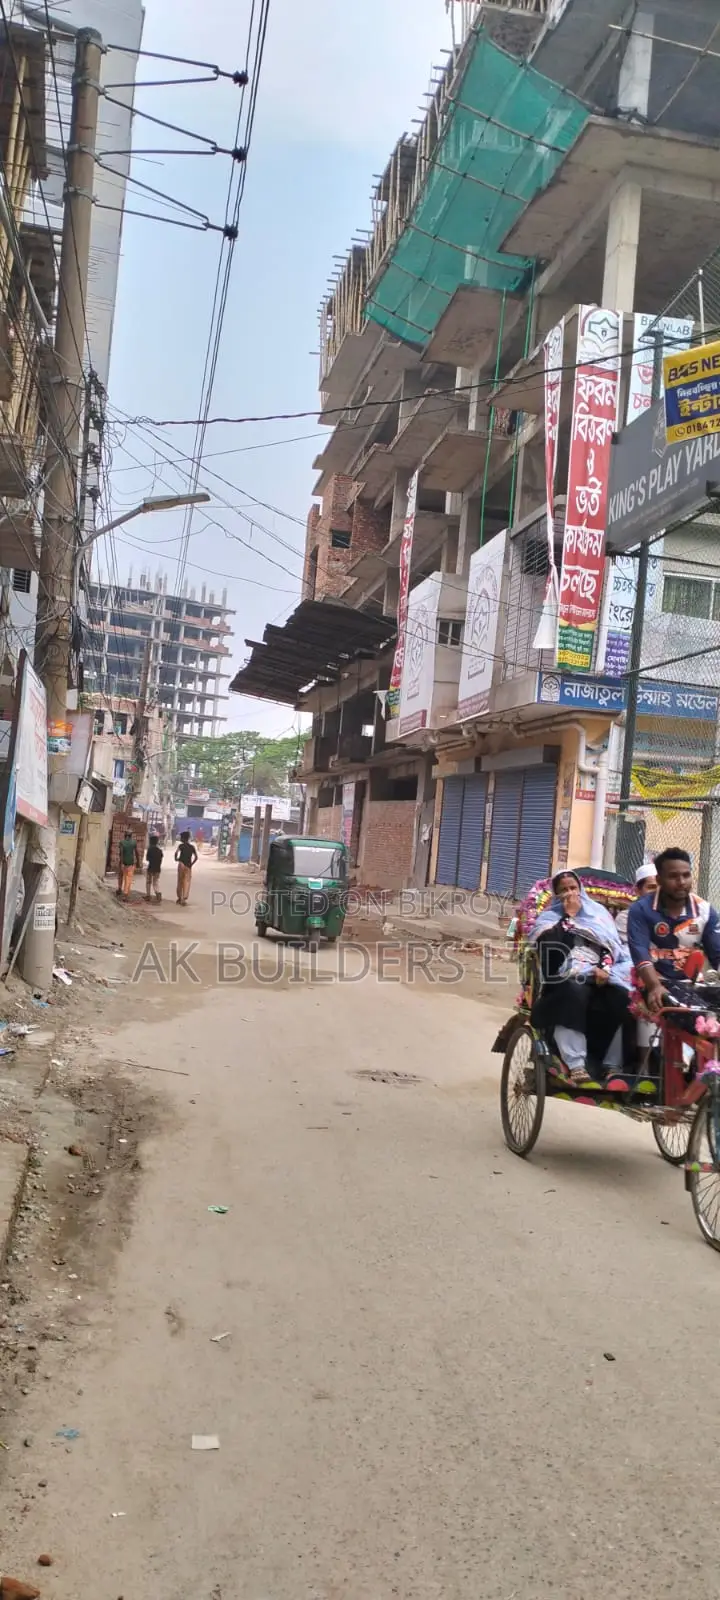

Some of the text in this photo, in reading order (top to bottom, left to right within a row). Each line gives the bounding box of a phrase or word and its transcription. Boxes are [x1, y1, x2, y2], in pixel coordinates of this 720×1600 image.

[608, 476, 646, 525] KING'S
[648, 449, 682, 500] PLAY
[560, 564, 600, 604] চলছে
[564, 681, 626, 706] নাজাতুল
